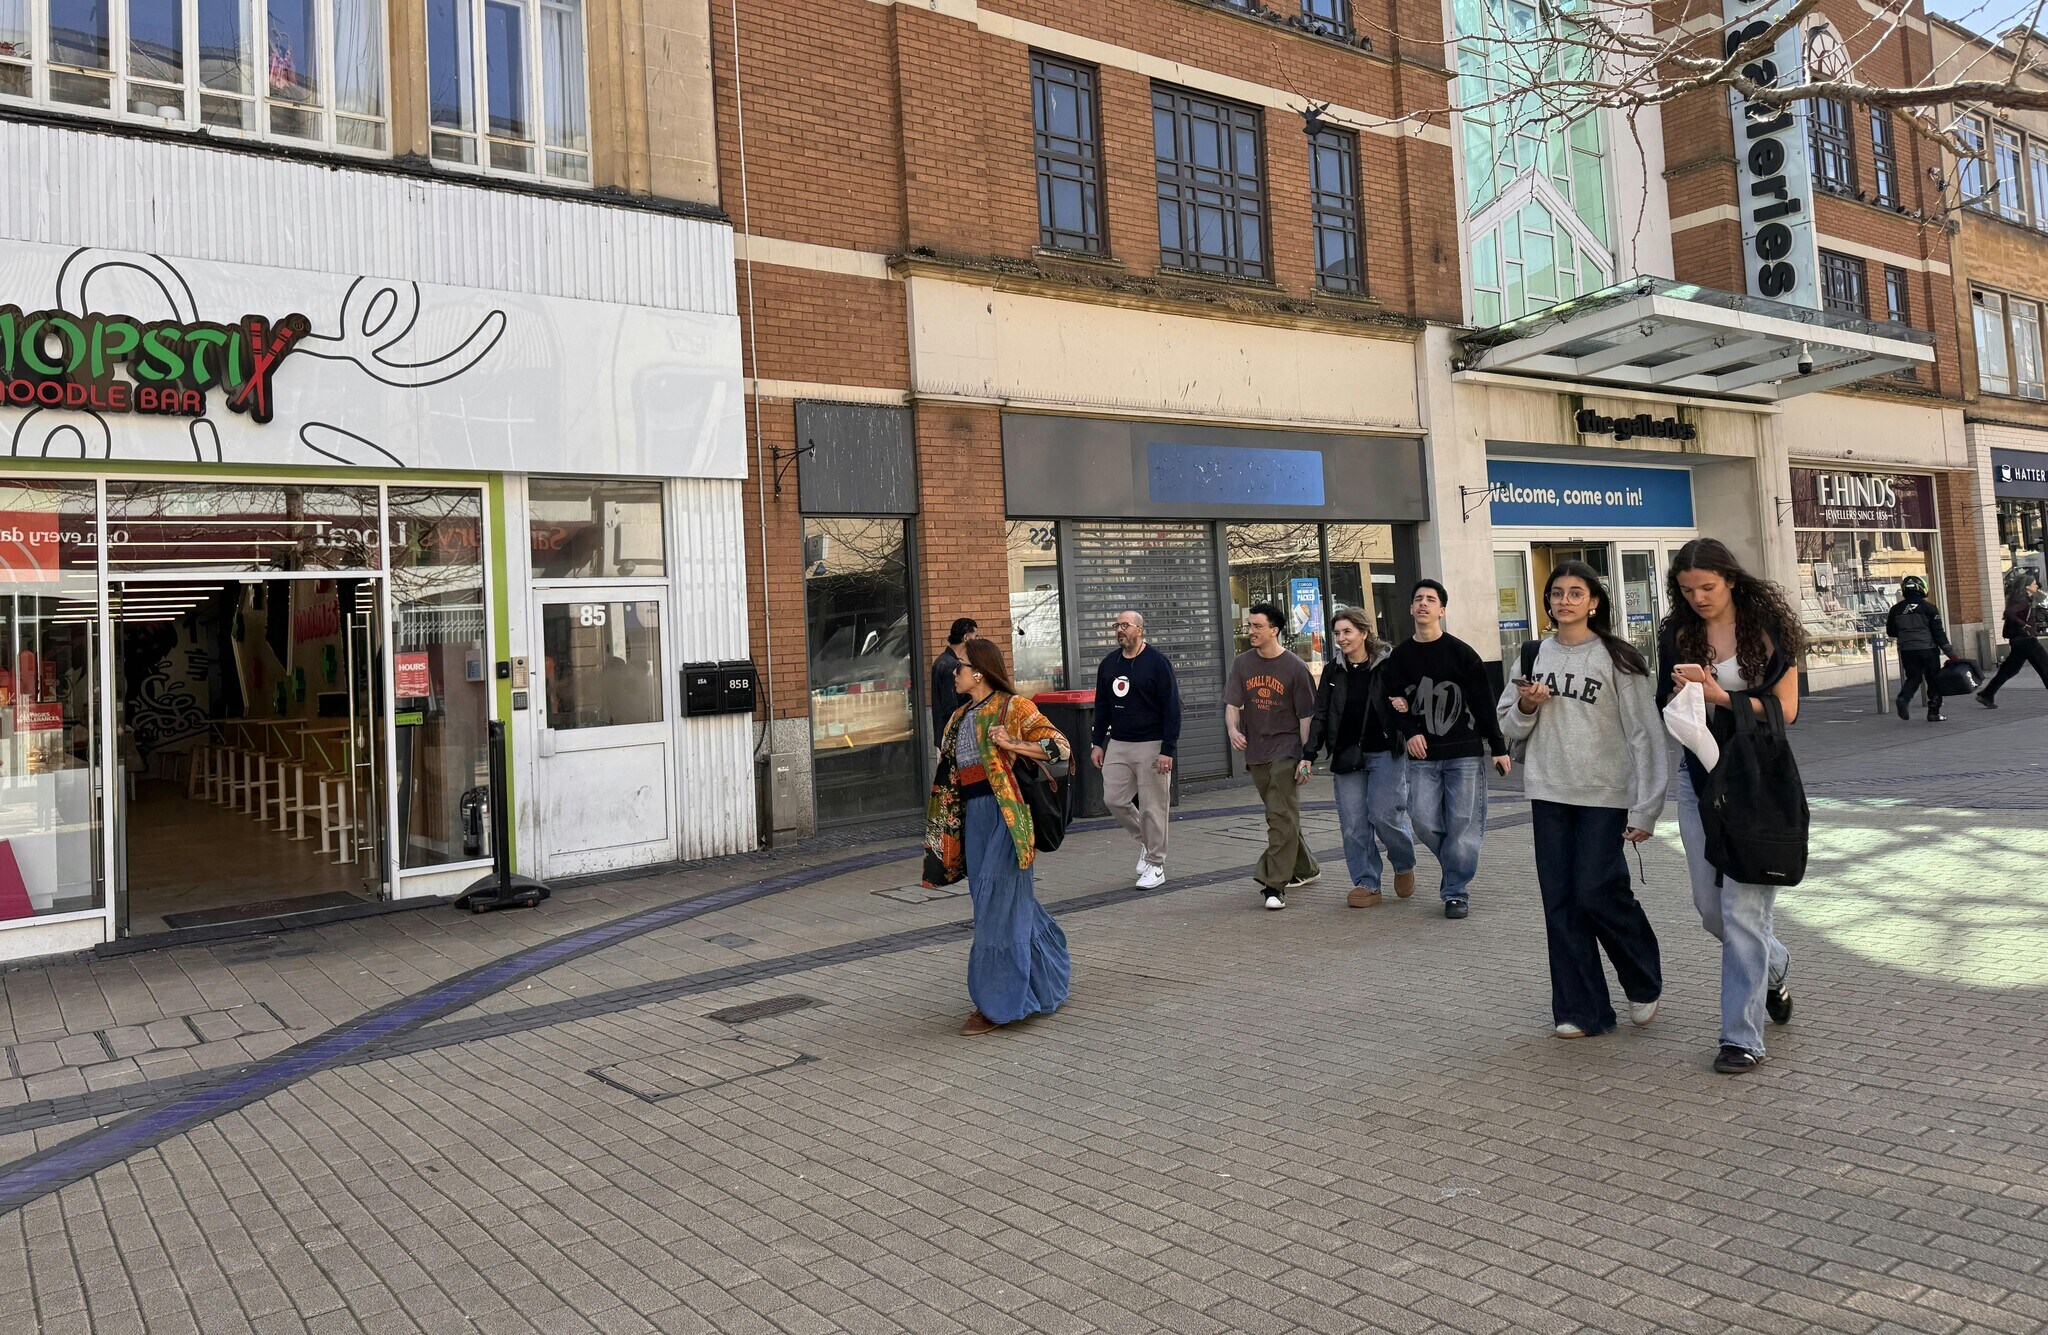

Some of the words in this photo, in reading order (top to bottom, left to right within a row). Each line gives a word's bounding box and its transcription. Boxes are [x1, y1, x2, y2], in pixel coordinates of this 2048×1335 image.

[0, 379, 126, 408] OODLE
[140, 387, 200, 412] BAR
[1575, 409, 1614, 434] the
[1614, 414, 1696, 441] galleries
[1490, 481, 1560, 506] Welcome,
[1563, 488, 1602, 505] come
[1607, 490, 1623, 505] on
[1626, 487, 1643, 506] in!
[1825, 509, 1857, 521] JEWELLERS
[1857, 510, 1875, 520] SINCE
[1876, 511, 1888, 521] 1856
[580, 605, 606, 626] 85
[398, 662, 426, 671] HOURS
[729, 679, 749, 689] 85B
[1245, 675, 1266, 691] SMALL
[1265, 675, 1285, 695] PLATES
